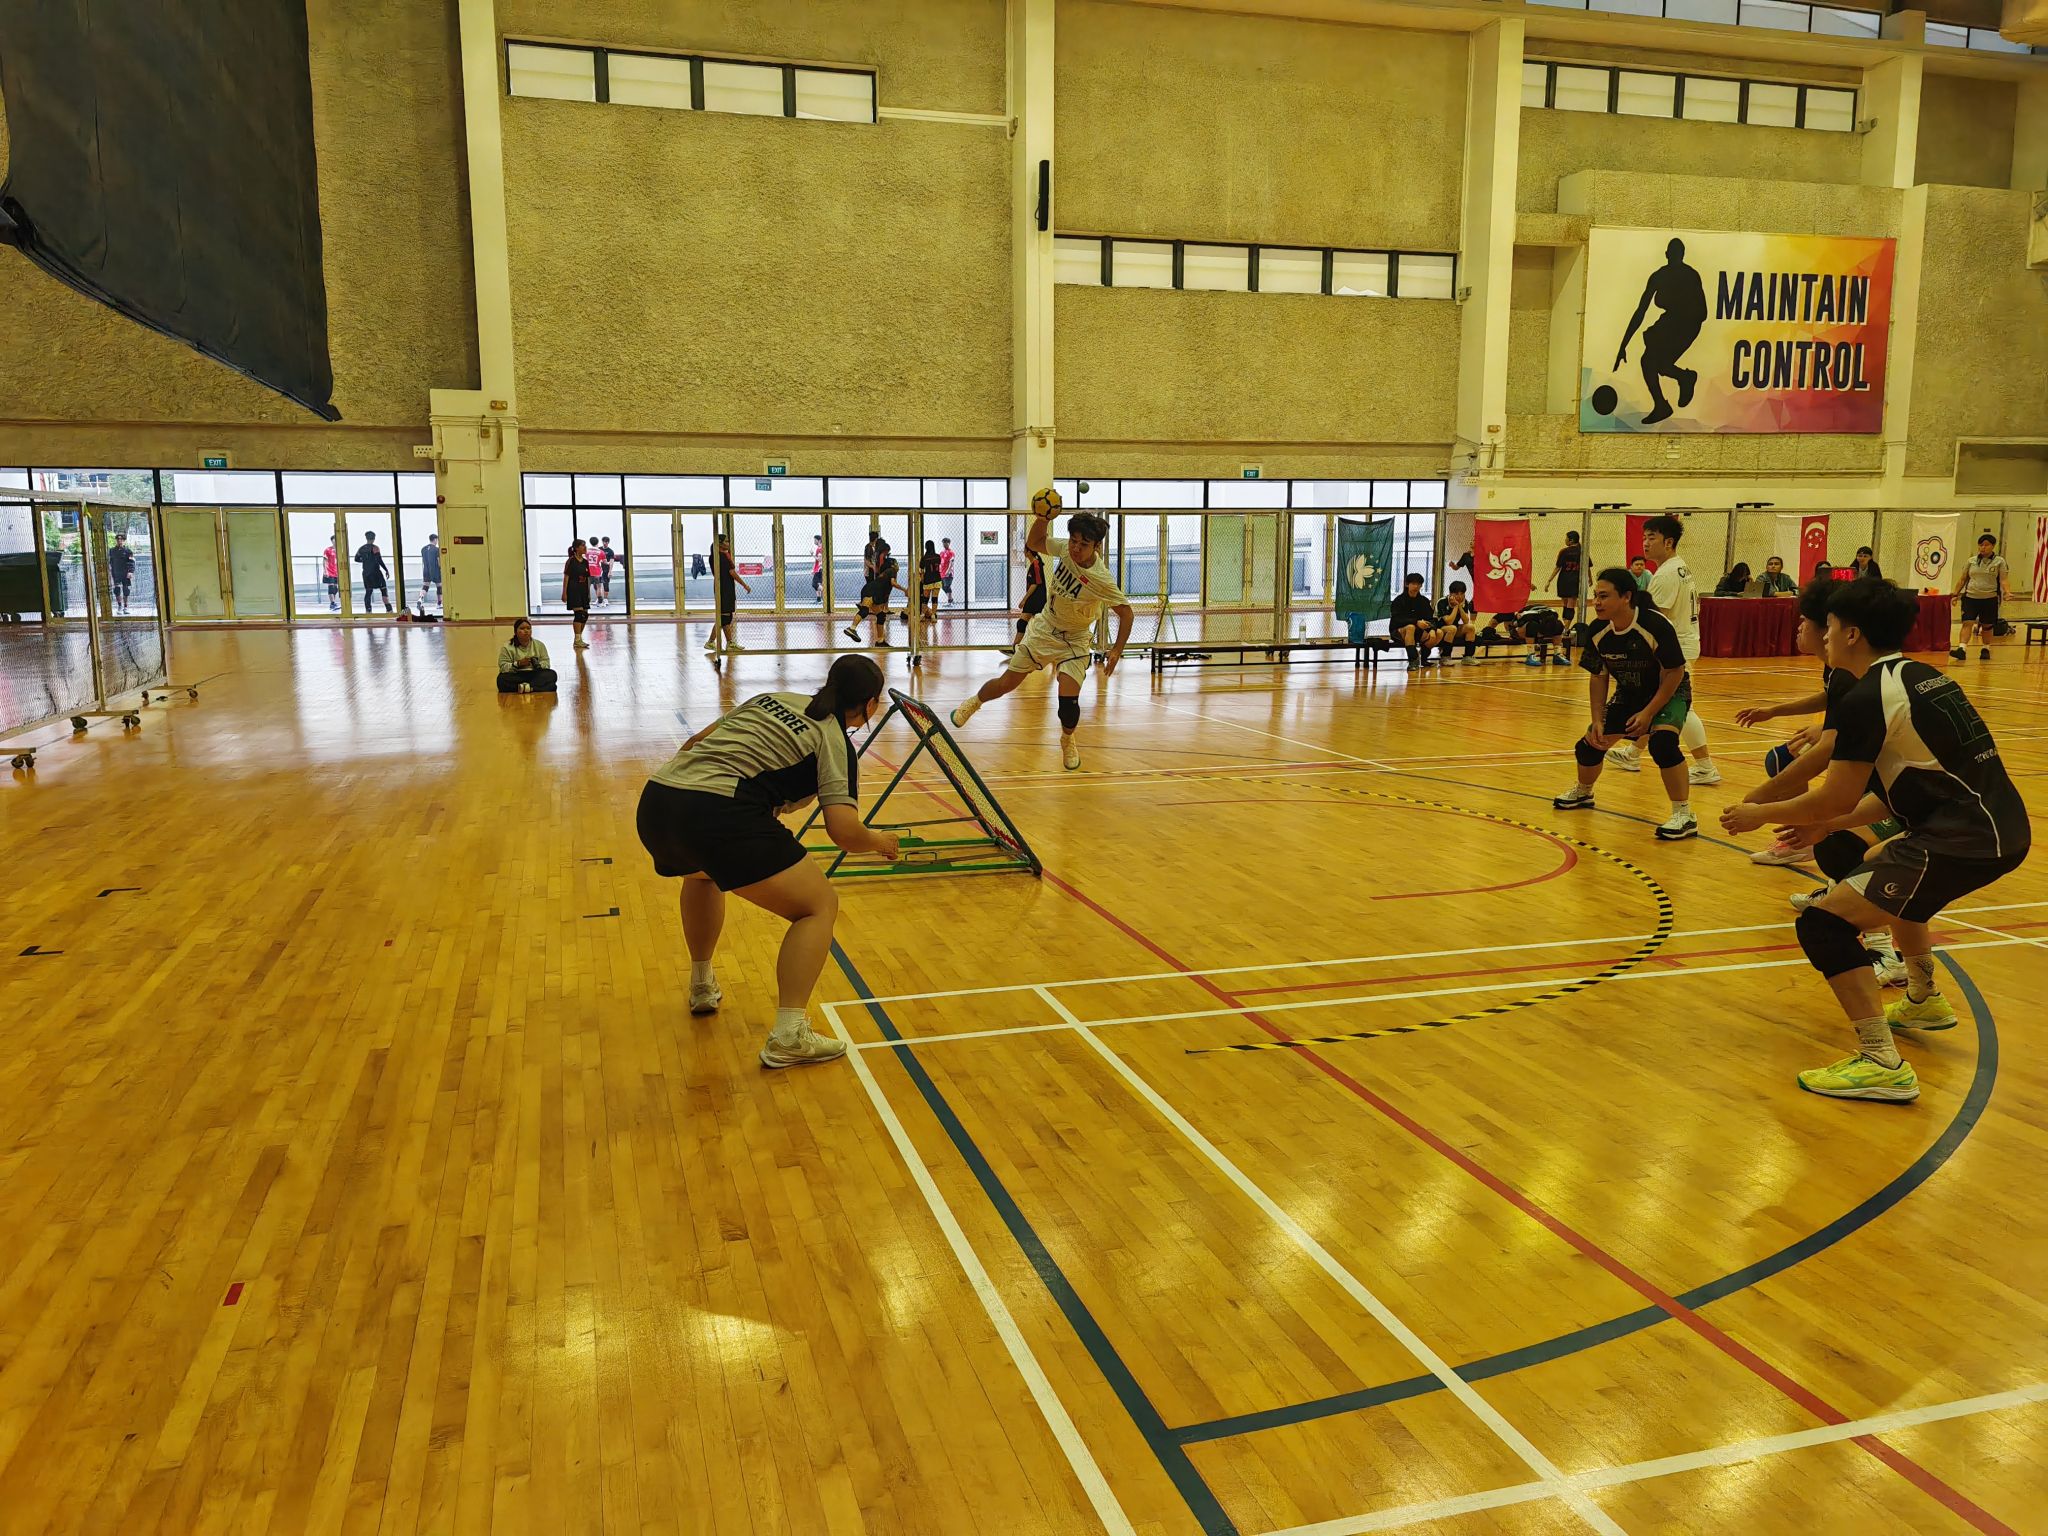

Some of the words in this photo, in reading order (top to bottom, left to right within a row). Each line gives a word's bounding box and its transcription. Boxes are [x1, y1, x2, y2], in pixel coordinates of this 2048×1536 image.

[1716, 271, 1870, 325] MAINTAIN
[1732, 340, 1870, 391] CONTROL
[1054, 557, 1083, 599] HINA
[756, 695, 811, 736] REFEREE
